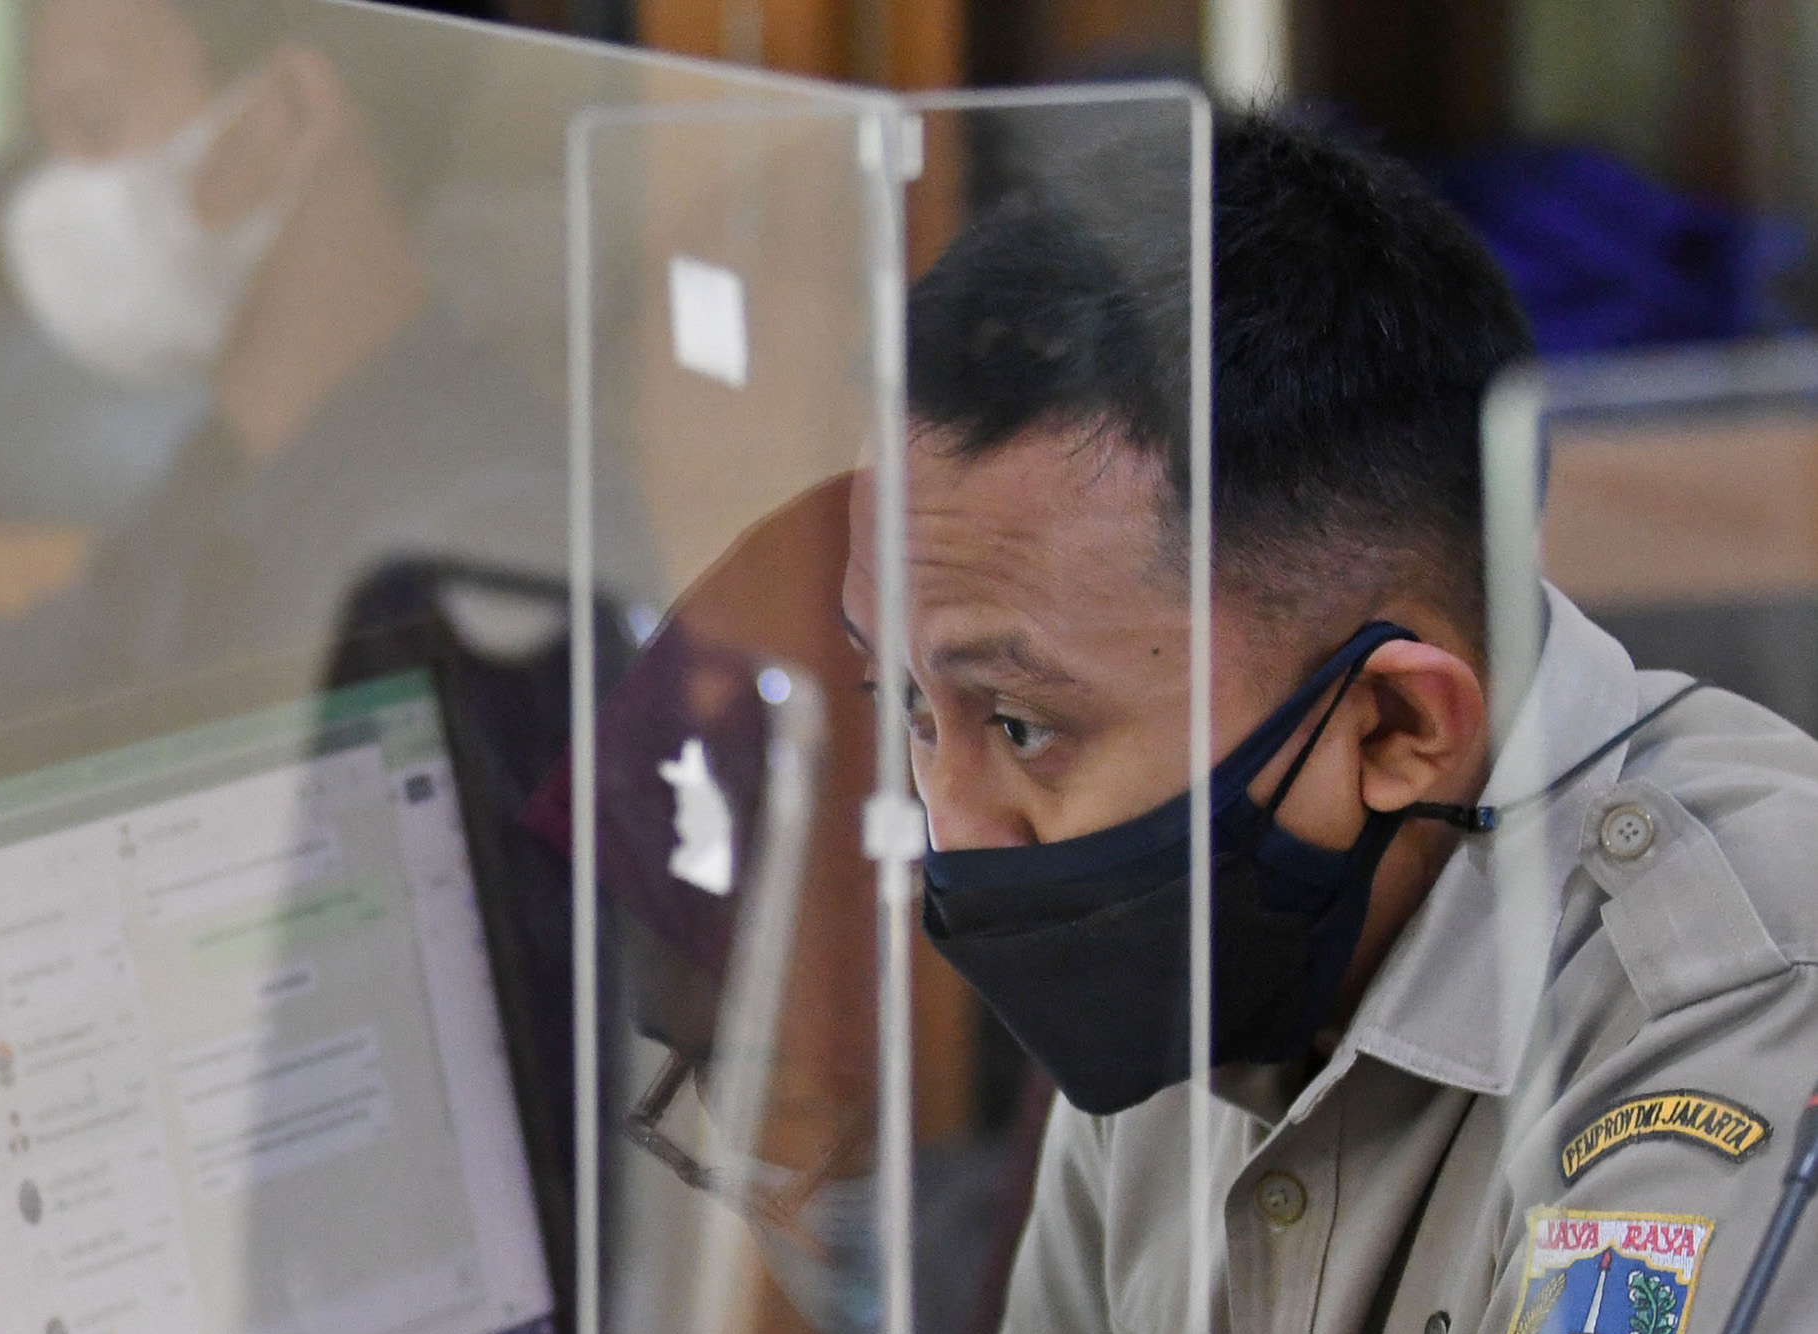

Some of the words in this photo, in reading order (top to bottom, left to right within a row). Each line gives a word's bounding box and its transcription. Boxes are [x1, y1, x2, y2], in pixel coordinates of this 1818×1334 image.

[1565, 1105, 1635, 1173] PEMPROV
[1662, 1101, 1752, 1151] JAKARTA
[1537, 1221, 1599, 1250] JAYA
[1622, 1224, 1696, 1257] RAYA
